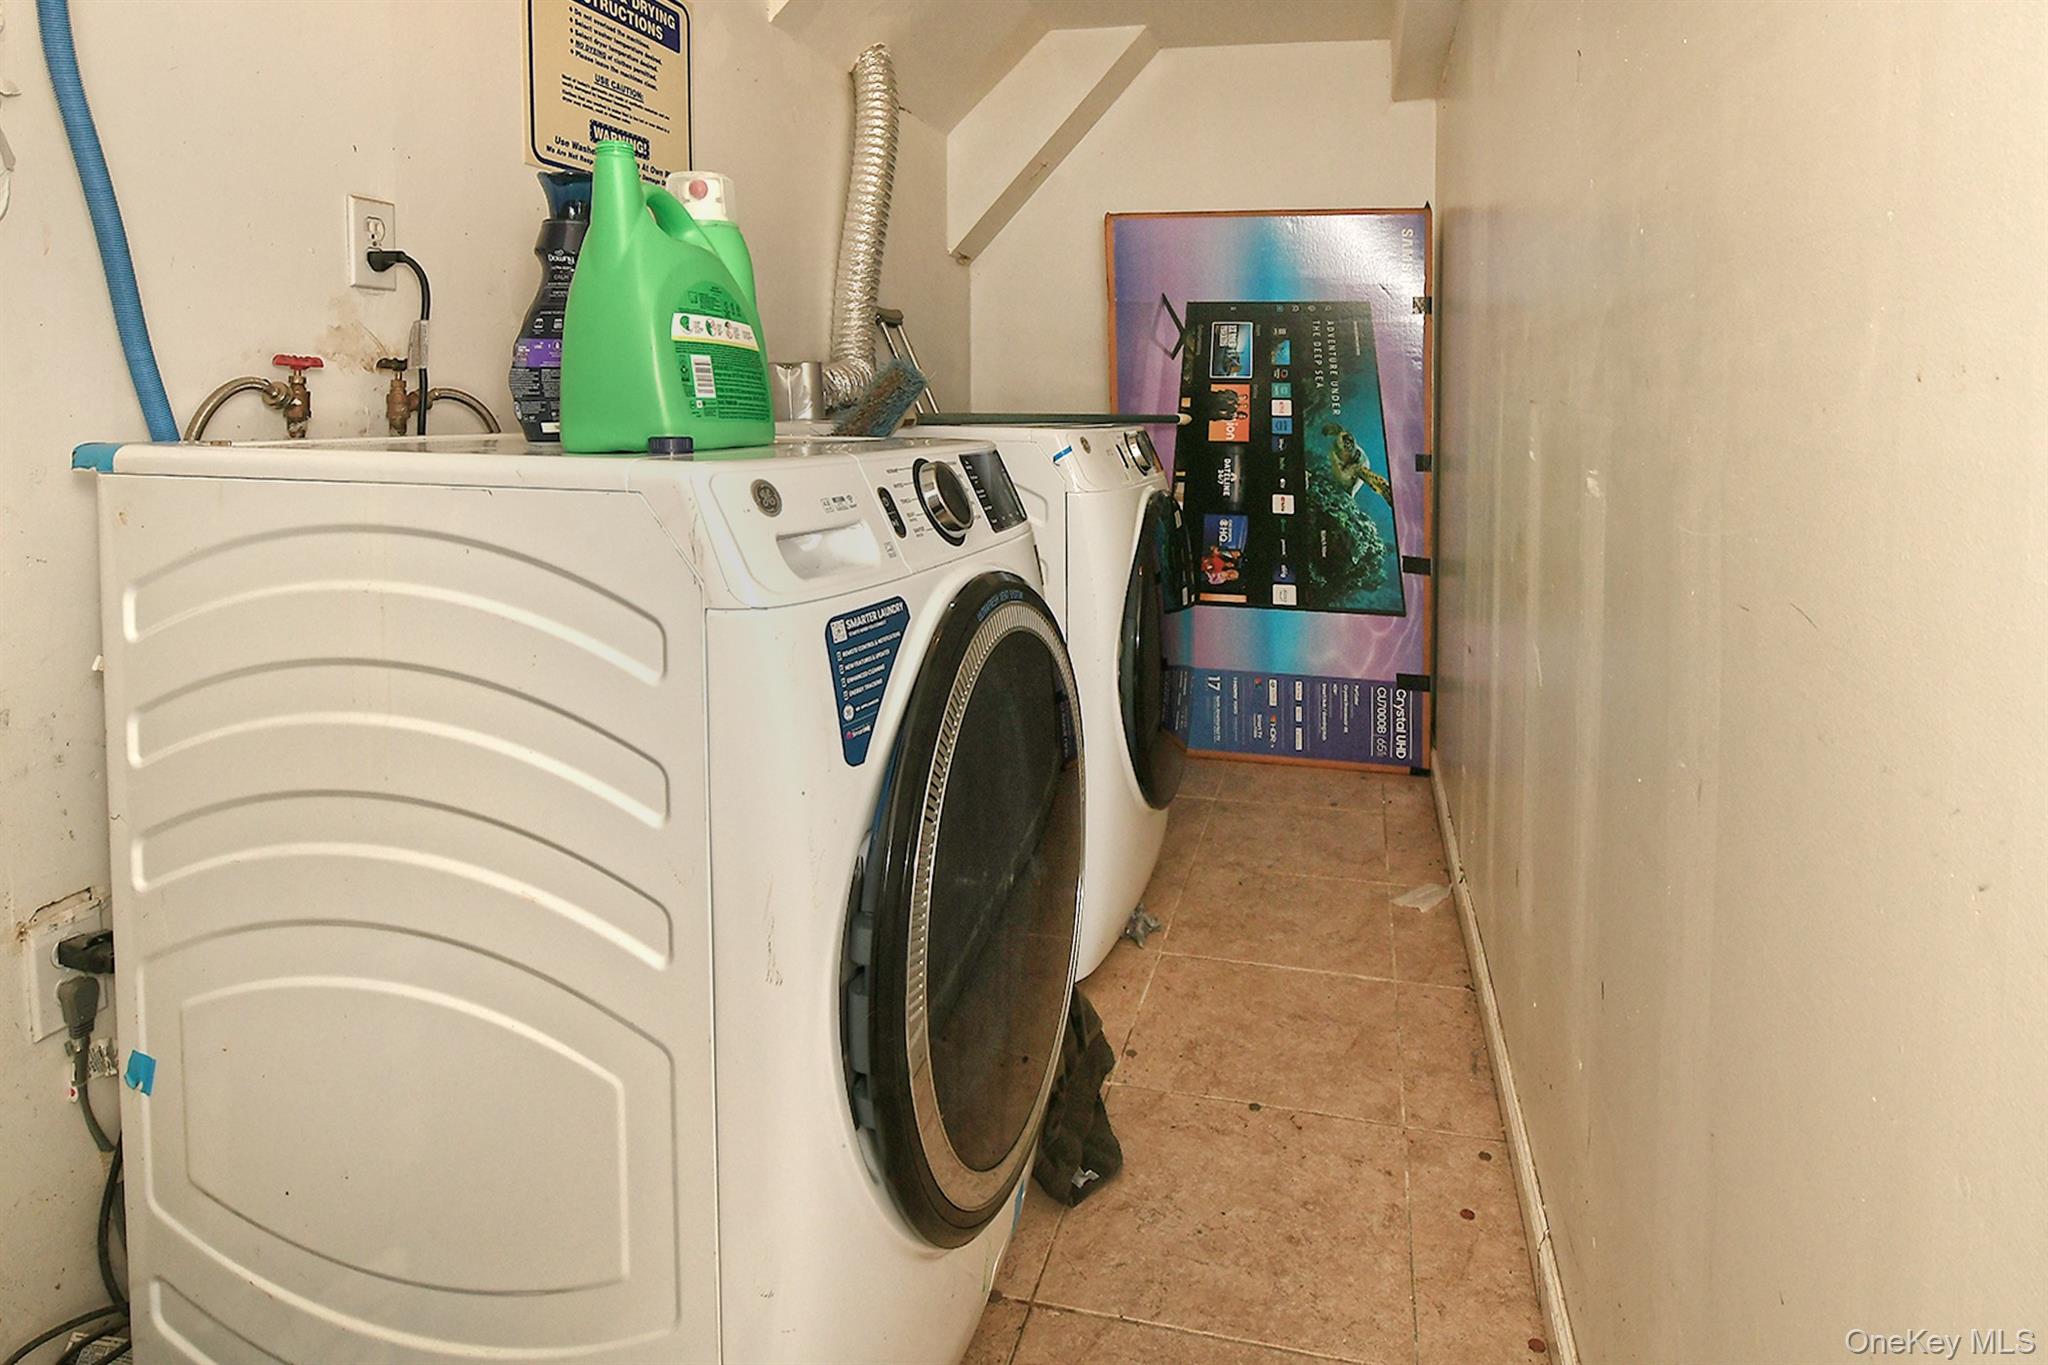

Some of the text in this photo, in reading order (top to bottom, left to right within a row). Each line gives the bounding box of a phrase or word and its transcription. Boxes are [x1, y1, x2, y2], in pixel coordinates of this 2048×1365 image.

[632, 0, 676, 30] DRYING
[594, 73, 610, 87] USE
[554, 135, 570, 148] Use
[547, 252, 576, 265] Downy
[1312, 320, 1324, 389] THE DEEP SEA
[1326, 320, 1341, 416] ADVENTURE UNDER
[1222, 458, 1232, 496] DATELINE
[845, 611, 878, 630] SMARTER
[877, 601, 904, 620] LAUNDRY
[1207, 676, 1221, 691] 17
[1393, 689, 1407, 759] Crystal UHD
